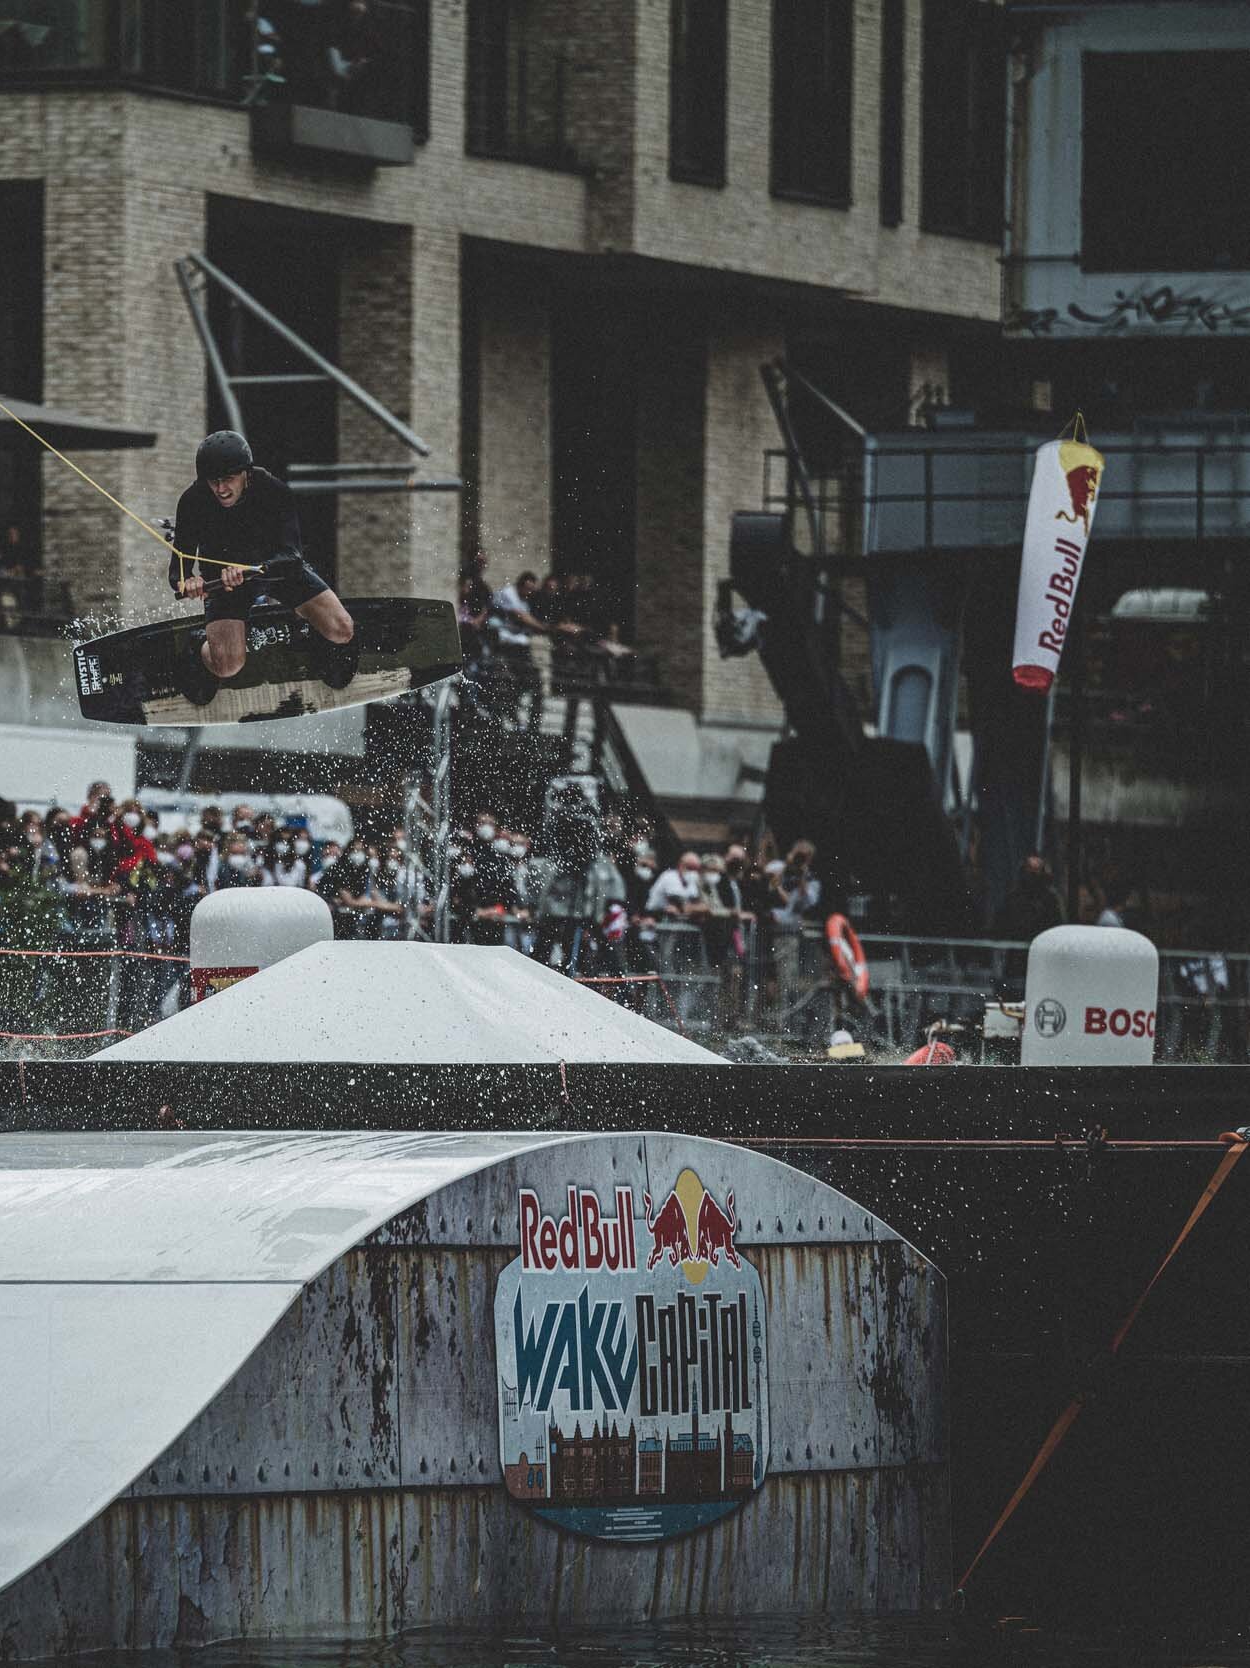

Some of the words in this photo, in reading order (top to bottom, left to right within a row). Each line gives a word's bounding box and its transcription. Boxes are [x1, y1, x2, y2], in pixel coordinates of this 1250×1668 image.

[1049, 538, 1081, 597] Bull
[1038, 594, 1070, 655] Red
[75, 649, 90, 687] MYSTIC
[520, 1187, 580, 1270] Red
[582, 1187, 637, 1271] Bull
[513, 1280, 638, 1416] WAKE
